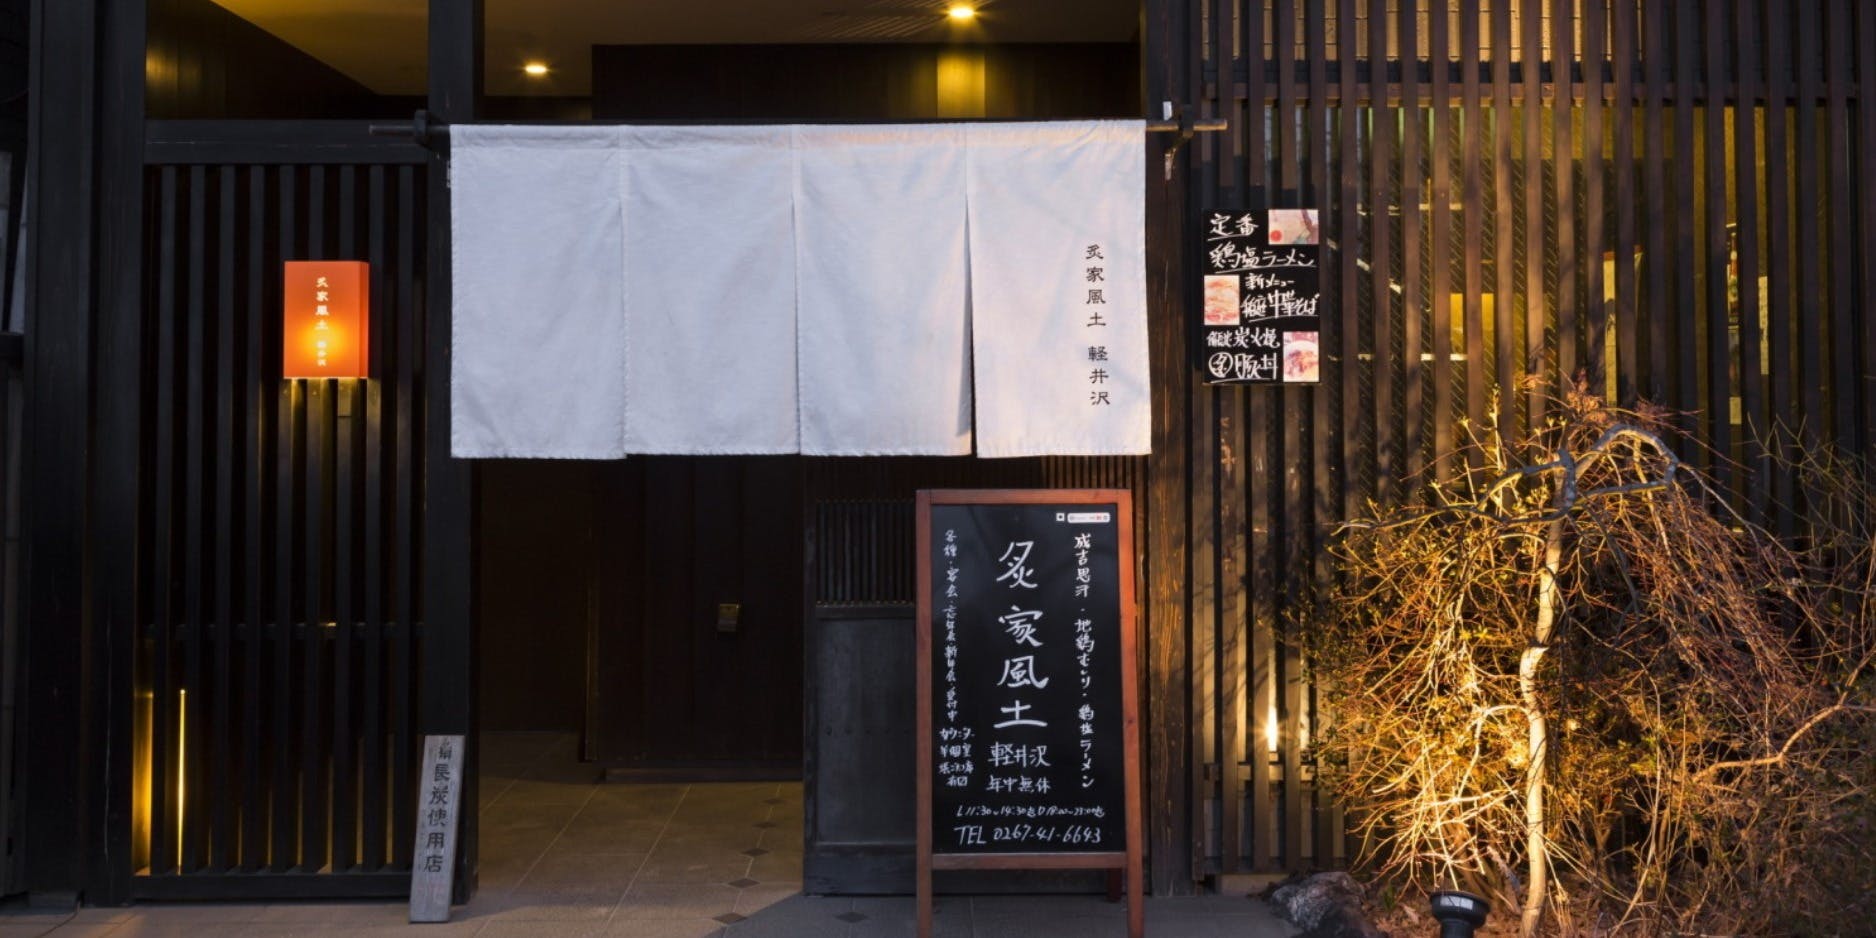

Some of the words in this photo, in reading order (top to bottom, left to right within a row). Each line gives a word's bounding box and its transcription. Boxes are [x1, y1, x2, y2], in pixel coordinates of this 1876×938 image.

[1209, 213, 1259, 236] 定番
[1086, 244, 1106, 327] 炙家風土
[1245, 273, 1295, 290] 新メニュー
[1088, 346, 1111, 405] 軽井沢
[994, 541, 1049, 728] 炙家風土
[988, 742, 1051, 768] 軽井沢
[986, 775, 1050, 794] 年中無休
[954, 825, 987, 845] TEL
[993, 824, 1101, 843] 0267-41-6643
